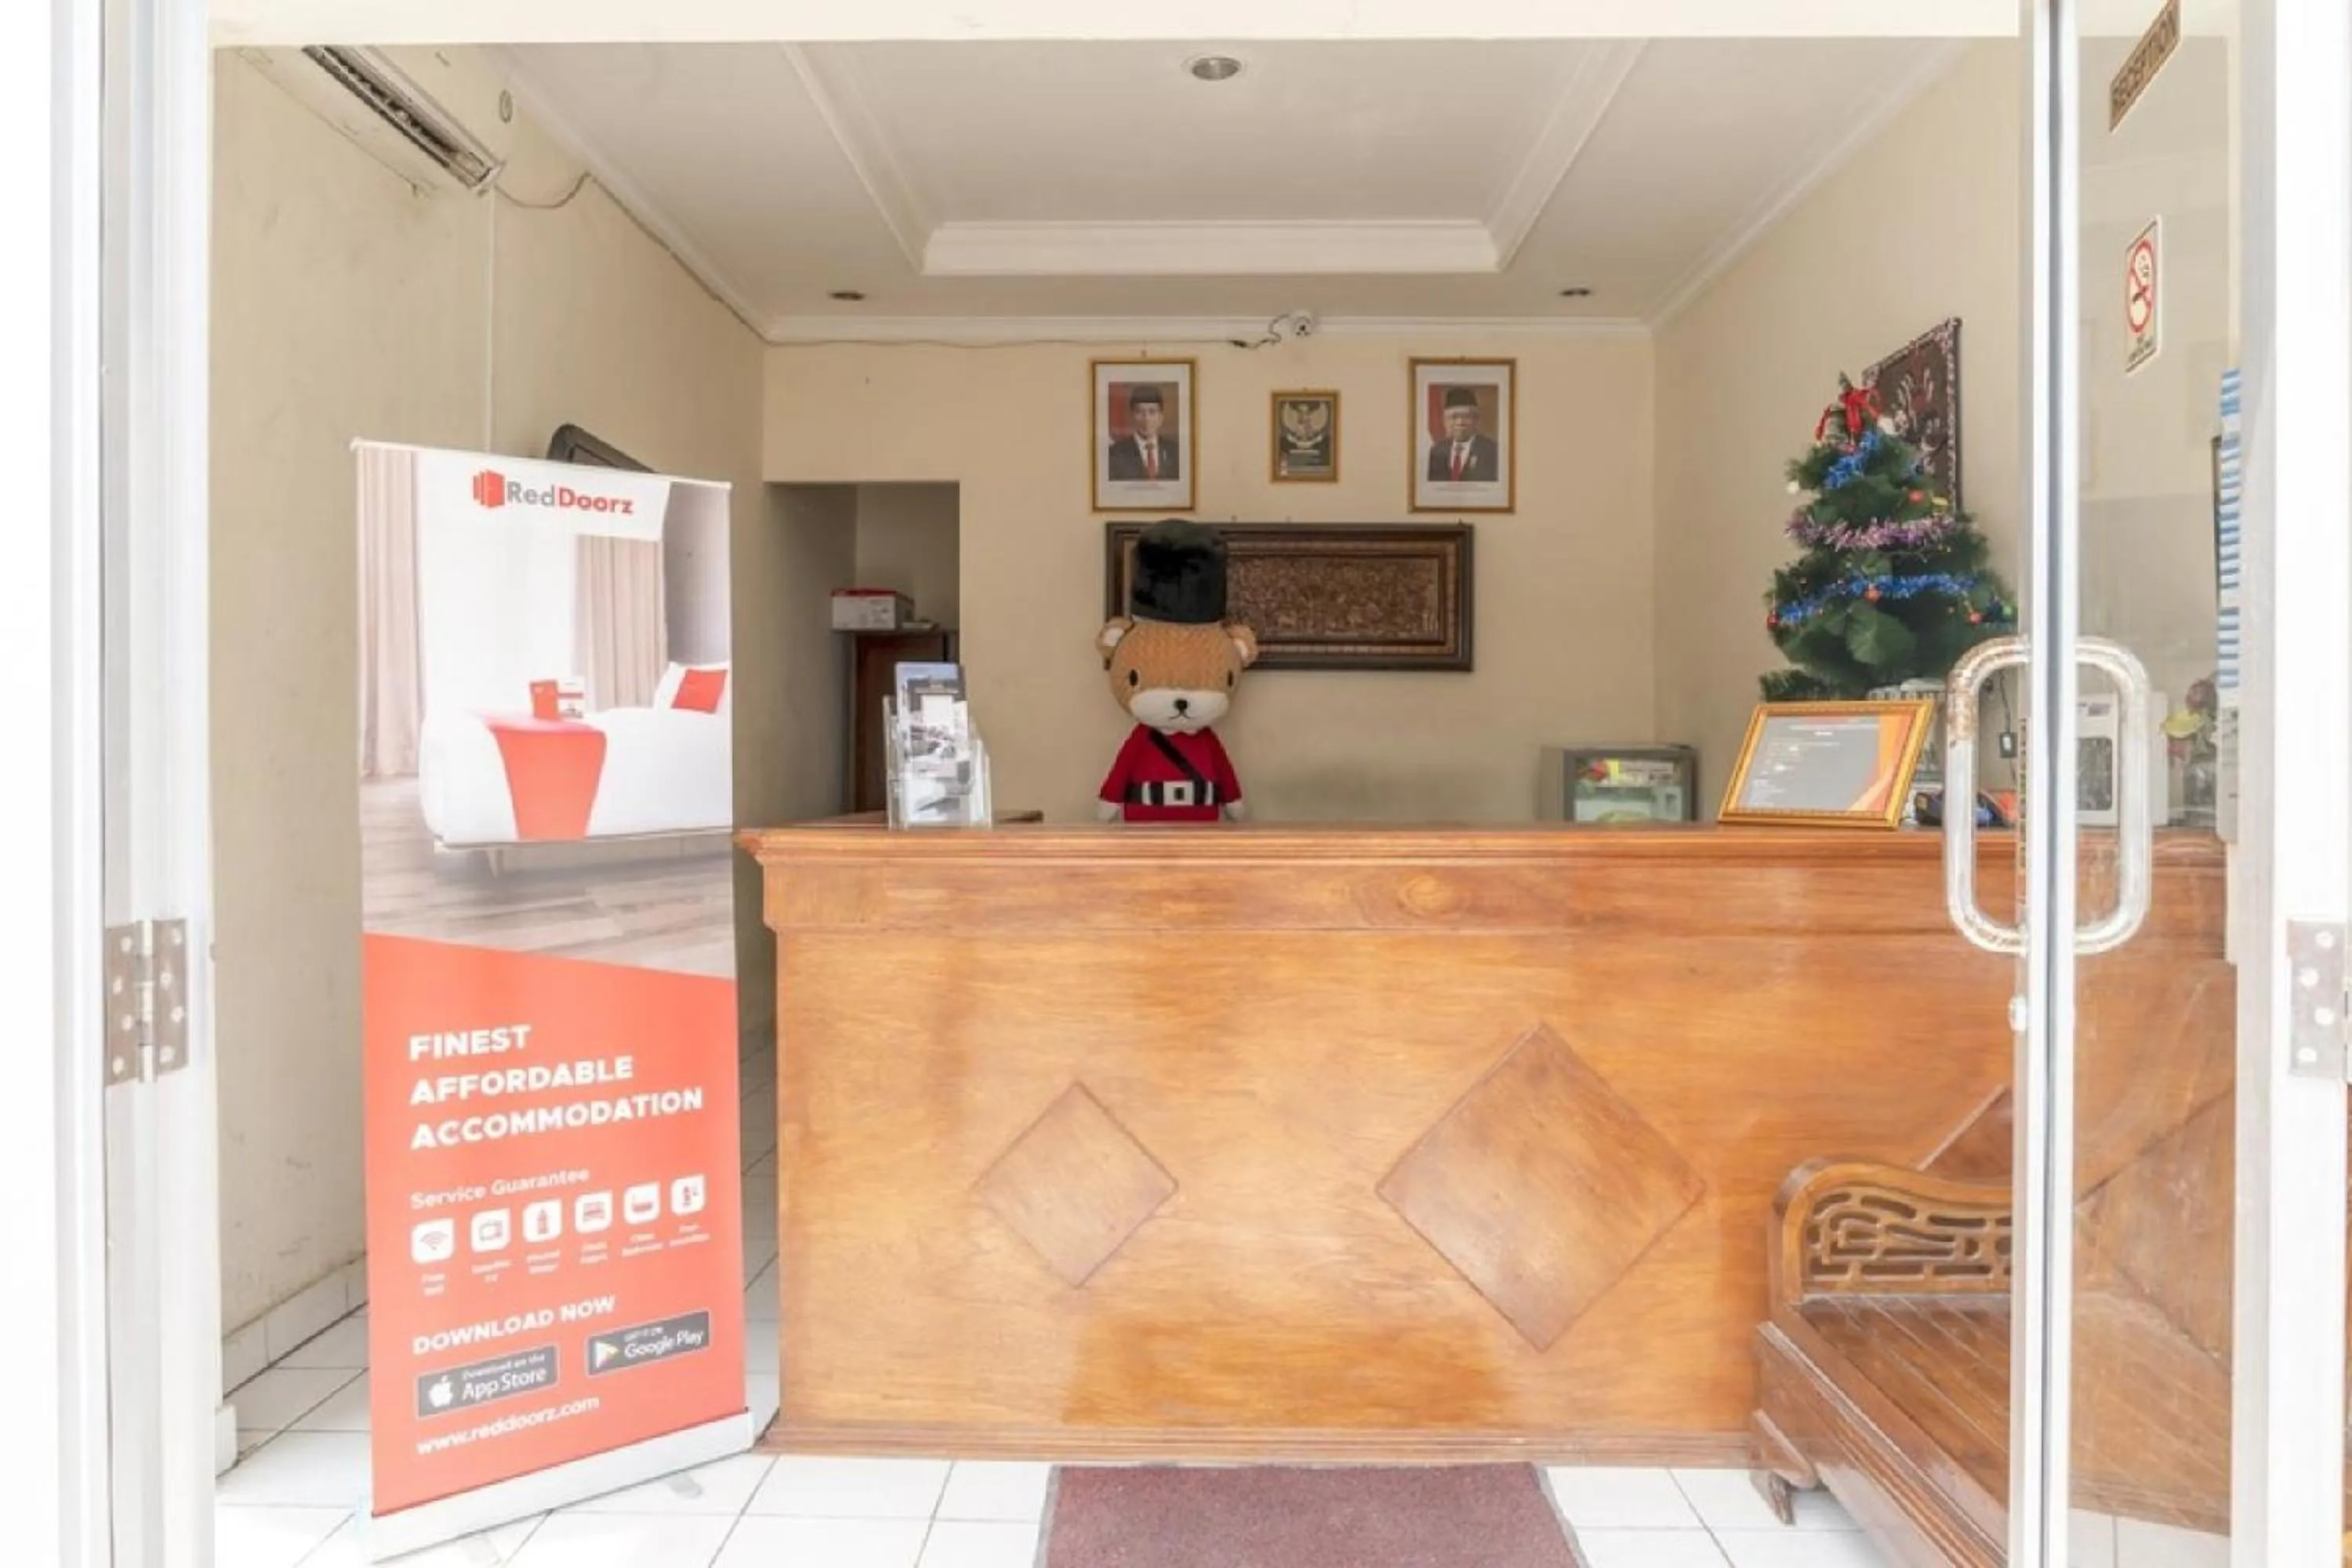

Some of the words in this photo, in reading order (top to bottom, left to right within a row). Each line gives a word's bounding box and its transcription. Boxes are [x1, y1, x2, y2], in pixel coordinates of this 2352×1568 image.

[506, 481, 634, 515] RedDoorz
[409, 1025, 532, 1062] FINEST
[410, 1055, 634, 1105] AFFORDABLE
[411, 1087, 703, 1150] ACCOMMODATION
[411, 1185, 486, 1210] Service
[490, 1169, 590, 1196] Guarantee
[412, 1308, 554, 1356] DOWNLOAD
[560, 1295, 616, 1323] NOW
[624, 1335, 674, 1359] Google
[677, 1329, 704, 1346] Play
[461, 1381, 499, 1402] App
[501, 1367, 547, 1392] Store
[416, 1396, 601, 1456] www.reddoorz.com
